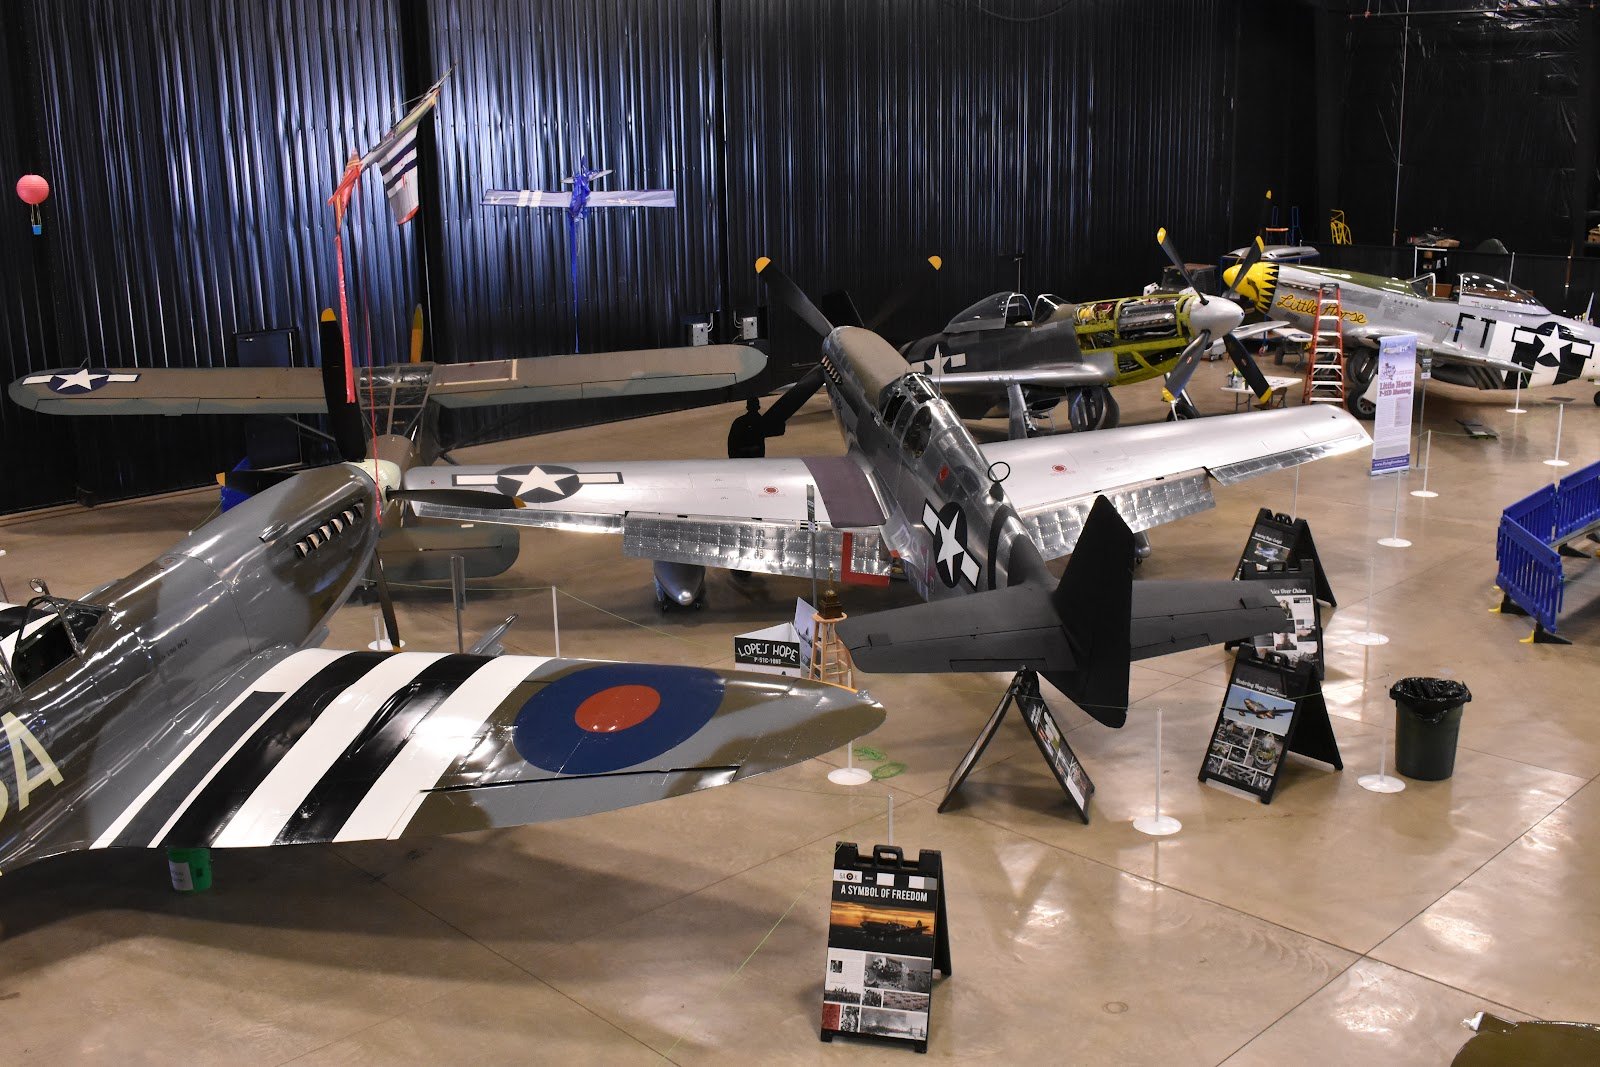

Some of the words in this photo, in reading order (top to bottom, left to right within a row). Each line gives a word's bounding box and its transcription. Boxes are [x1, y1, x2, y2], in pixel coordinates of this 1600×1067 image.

[1277, 294, 1318, 315] Little
[1379, 381, 1395, 390] Little
[1396, 380, 1412, 388] Horse
[738, 643, 769, 657] LOPE'S
[772, 644, 799, 662] HOPE
[840, 884, 846, 894] A
[848, 884, 879, 898] SYMBOL
[880, 887, 890, 899] OF
[891, 889, 928, 902] FREEDOM
